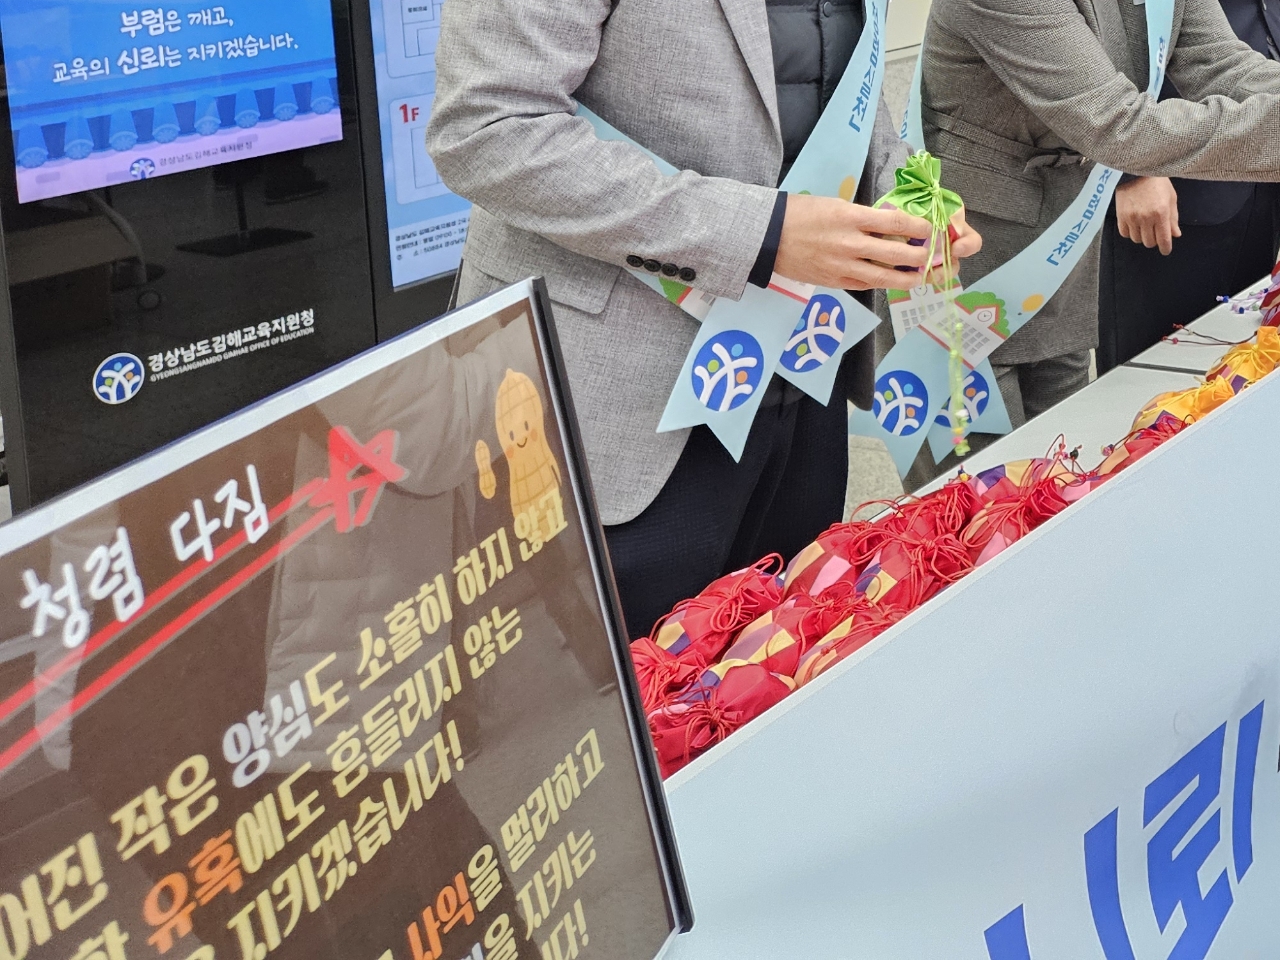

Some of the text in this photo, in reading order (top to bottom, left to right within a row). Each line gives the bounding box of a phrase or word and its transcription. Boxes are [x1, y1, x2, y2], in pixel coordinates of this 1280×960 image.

[52, 32, 299, 83] 교육의 신뢰는 지키겠습니다.
[120, 5, 234, 38] 부럼은 깨고,
[398, 103, 420, 124] 1F
[1045, 166, 1114, 267] 청렴실천
[148, 307, 315, 373] 경상남도김해교육지원청
[150, 353, 223, 383] GYEONGSANGNAMDO
[19, 463, 271, 648] 청렴 다짐
[110, 753, 219, 862] 작은
[222, 651, 350, 788] 양심도
[356, 573, 453, 691] 소홀히
[452, 526, 514, 606] 하지
[513, 488, 569, 563] 않고
[142, 605, 524, 954] 유혹에도 흔들리지 않는
[499, 727, 606, 873] 멀리하고
[227, 719, 465, 960] 지키겠습니다!
[514, 827, 597, 941] 지키는
